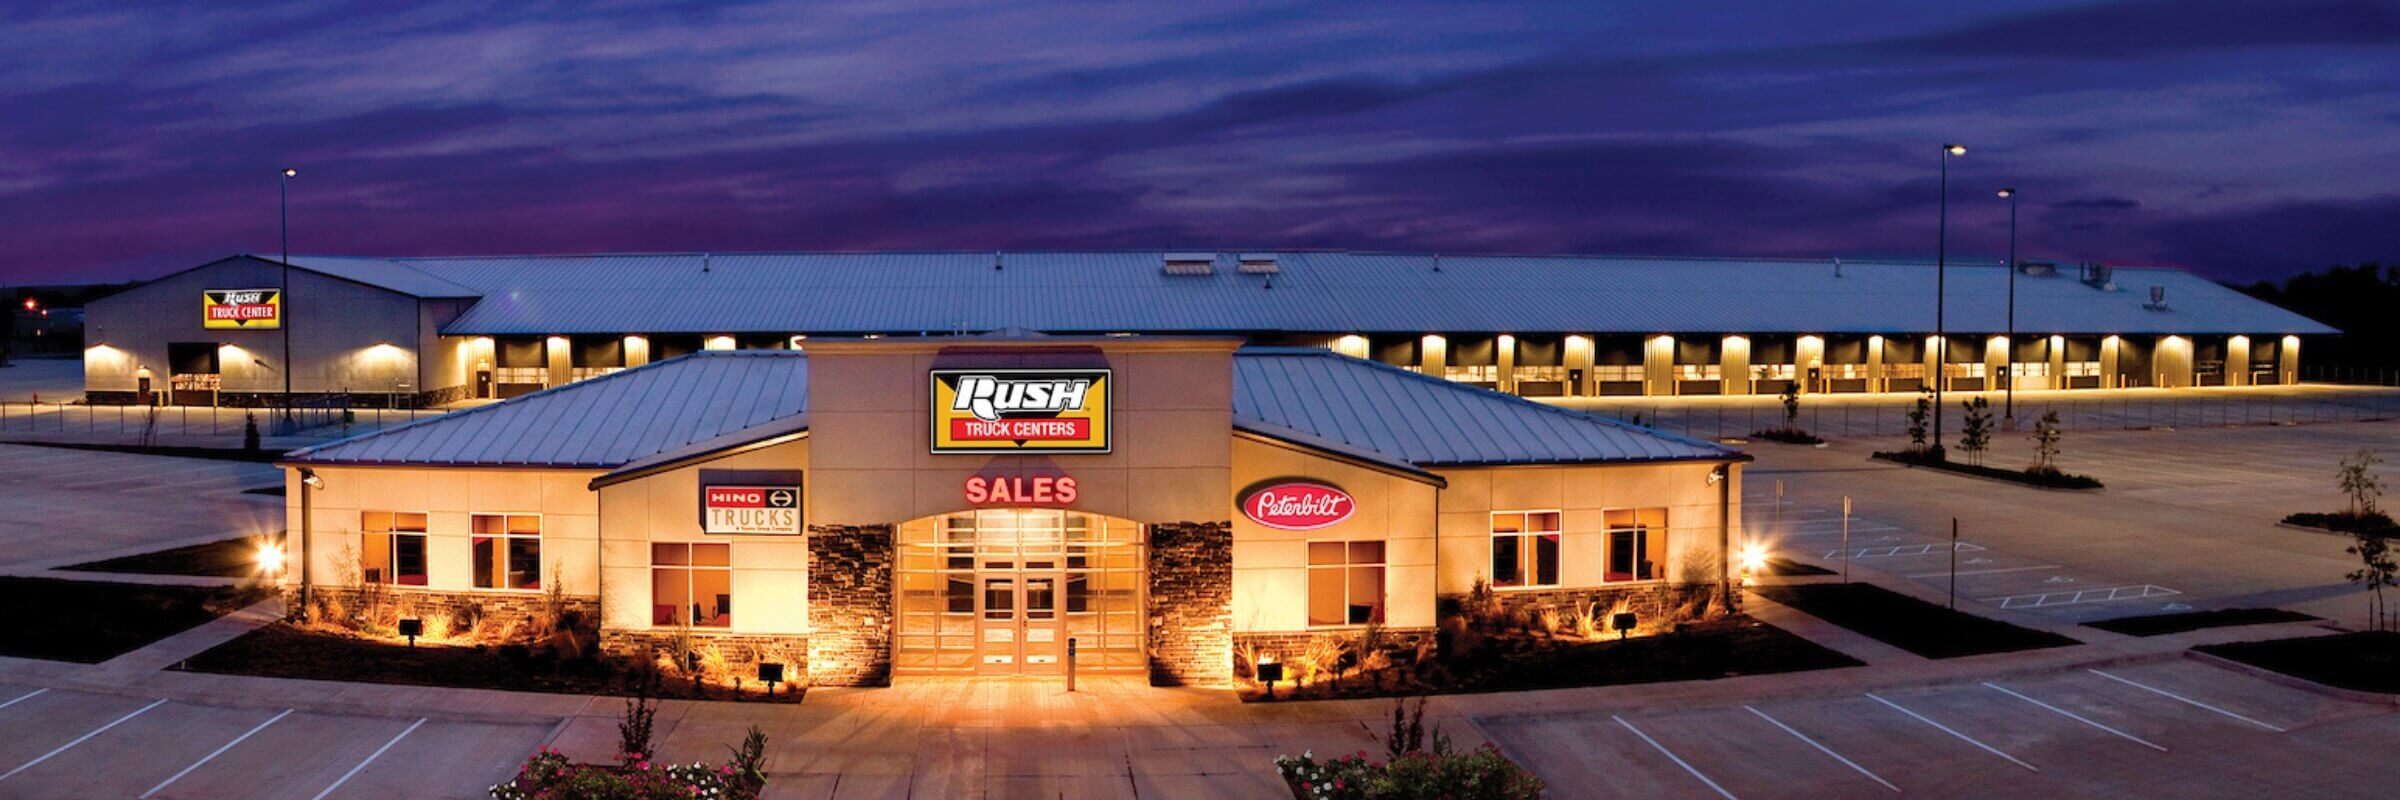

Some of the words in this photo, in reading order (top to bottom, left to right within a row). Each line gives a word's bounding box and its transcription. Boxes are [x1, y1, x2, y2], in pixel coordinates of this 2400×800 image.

[212, 306, 239, 318] TRUCK
[241, 306, 273, 318] CENTER
[952, 375, 1090, 422] RUSH
[965, 422, 1010, 436] TRUCK
[1013, 422, 1076, 436] CENTERS
[711, 493, 761, 504] HINO
[966, 477, 1077, 503] SALES
[1257, 491, 1347, 519] Peterbilt
[711, 509, 793, 526] TRUCKS
